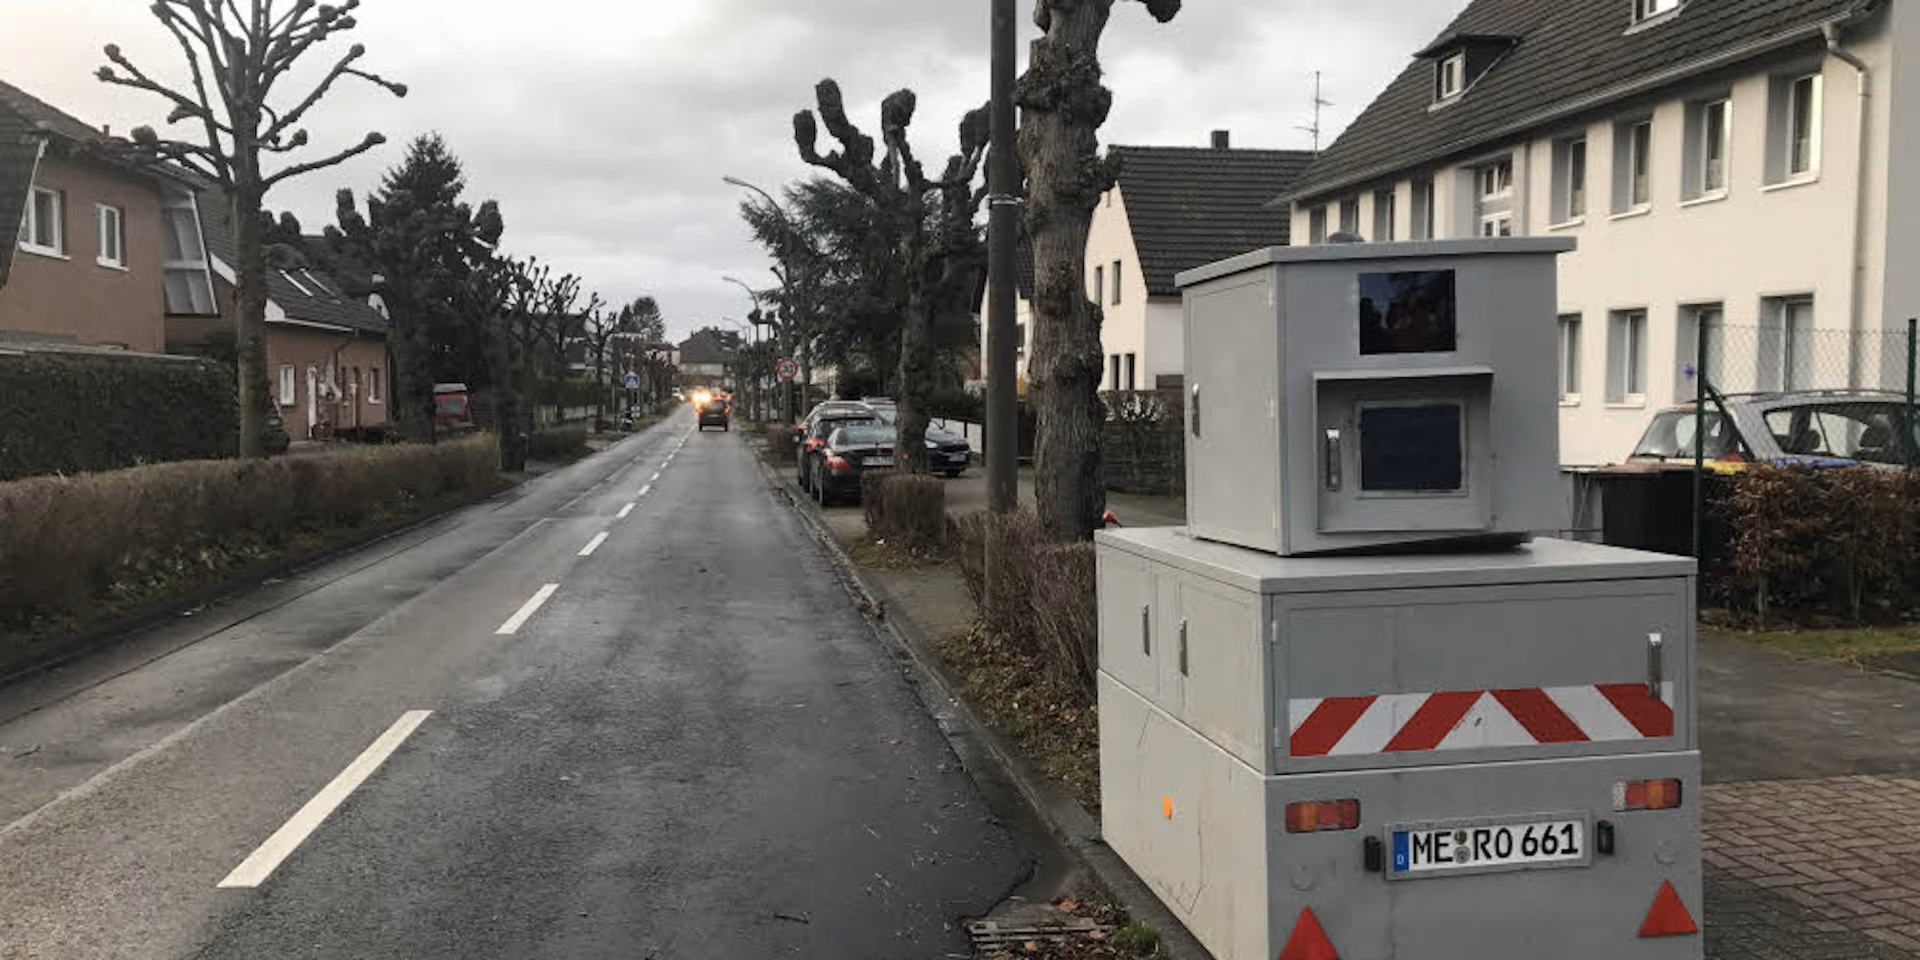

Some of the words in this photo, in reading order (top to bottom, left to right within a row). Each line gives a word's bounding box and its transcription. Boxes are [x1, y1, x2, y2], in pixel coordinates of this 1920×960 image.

[1413, 832, 1453, 864] ME
[1474, 828, 1513, 860] RO
[1521, 824, 1578, 857] 661
[1397, 853, 1404, 865] D
